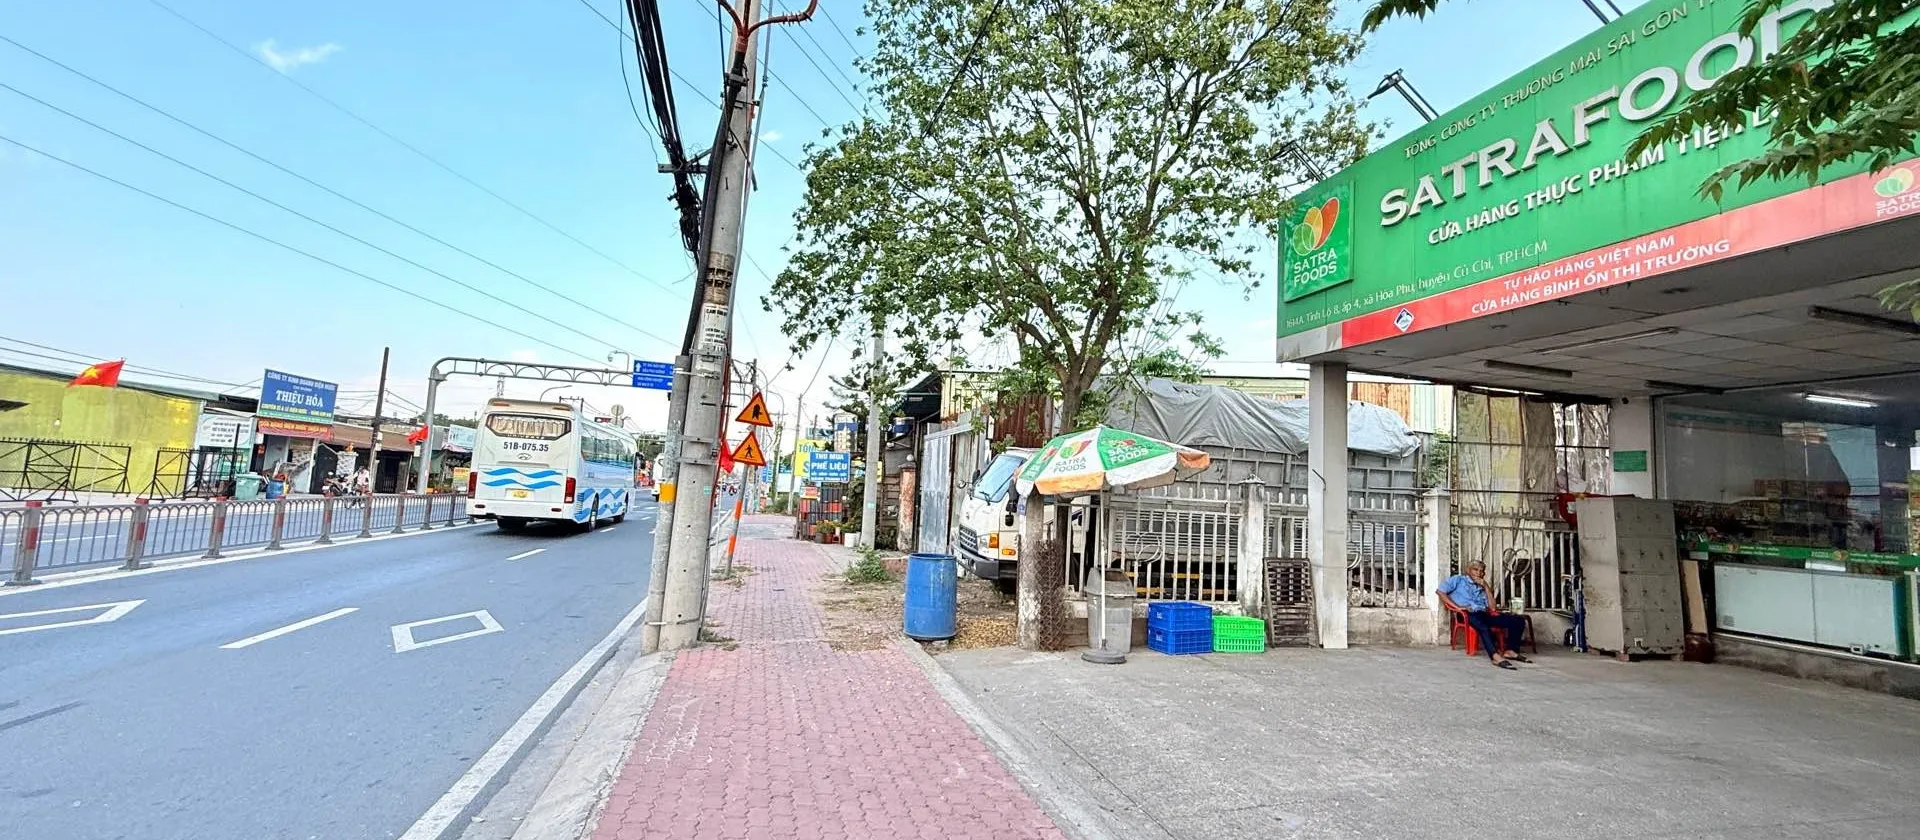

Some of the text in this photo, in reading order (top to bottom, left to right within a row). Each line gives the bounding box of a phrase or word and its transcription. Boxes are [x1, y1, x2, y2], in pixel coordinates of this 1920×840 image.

[1480, 101, 1498, 121] TY
[1428, 220, 1463, 245] CỬA
[1466, 199, 1520, 233] HÀNG
[1524, 173, 1583, 211] THỰC
[1294, 248, 1338, 274] SATRA
[1498, 239, 1548, 265] TP.HCM
[1503, 235, 1676, 291] TỰ HÀO HÀNG VIỆT NAM
[1294, 261, 1338, 288] FOODS
[1472, 300, 1498, 314] CỬA
[1501, 289, 1540, 307] HÀNG
[1543, 277, 1580, 297] BÌNH
[1612, 262, 1641, 279] THỊ
[1644, 238, 1731, 272] TRƯỜNG
[503, 441, 549, 452] 51B-075.35
[1110, 447, 1149, 466] FOODS
[811, 460, 827, 470] PHẾ
[829, 460, 848, 472] LIỆU
[1053, 462, 1087, 473] FOODS
[1055, 456, 1087, 467] SATRA
